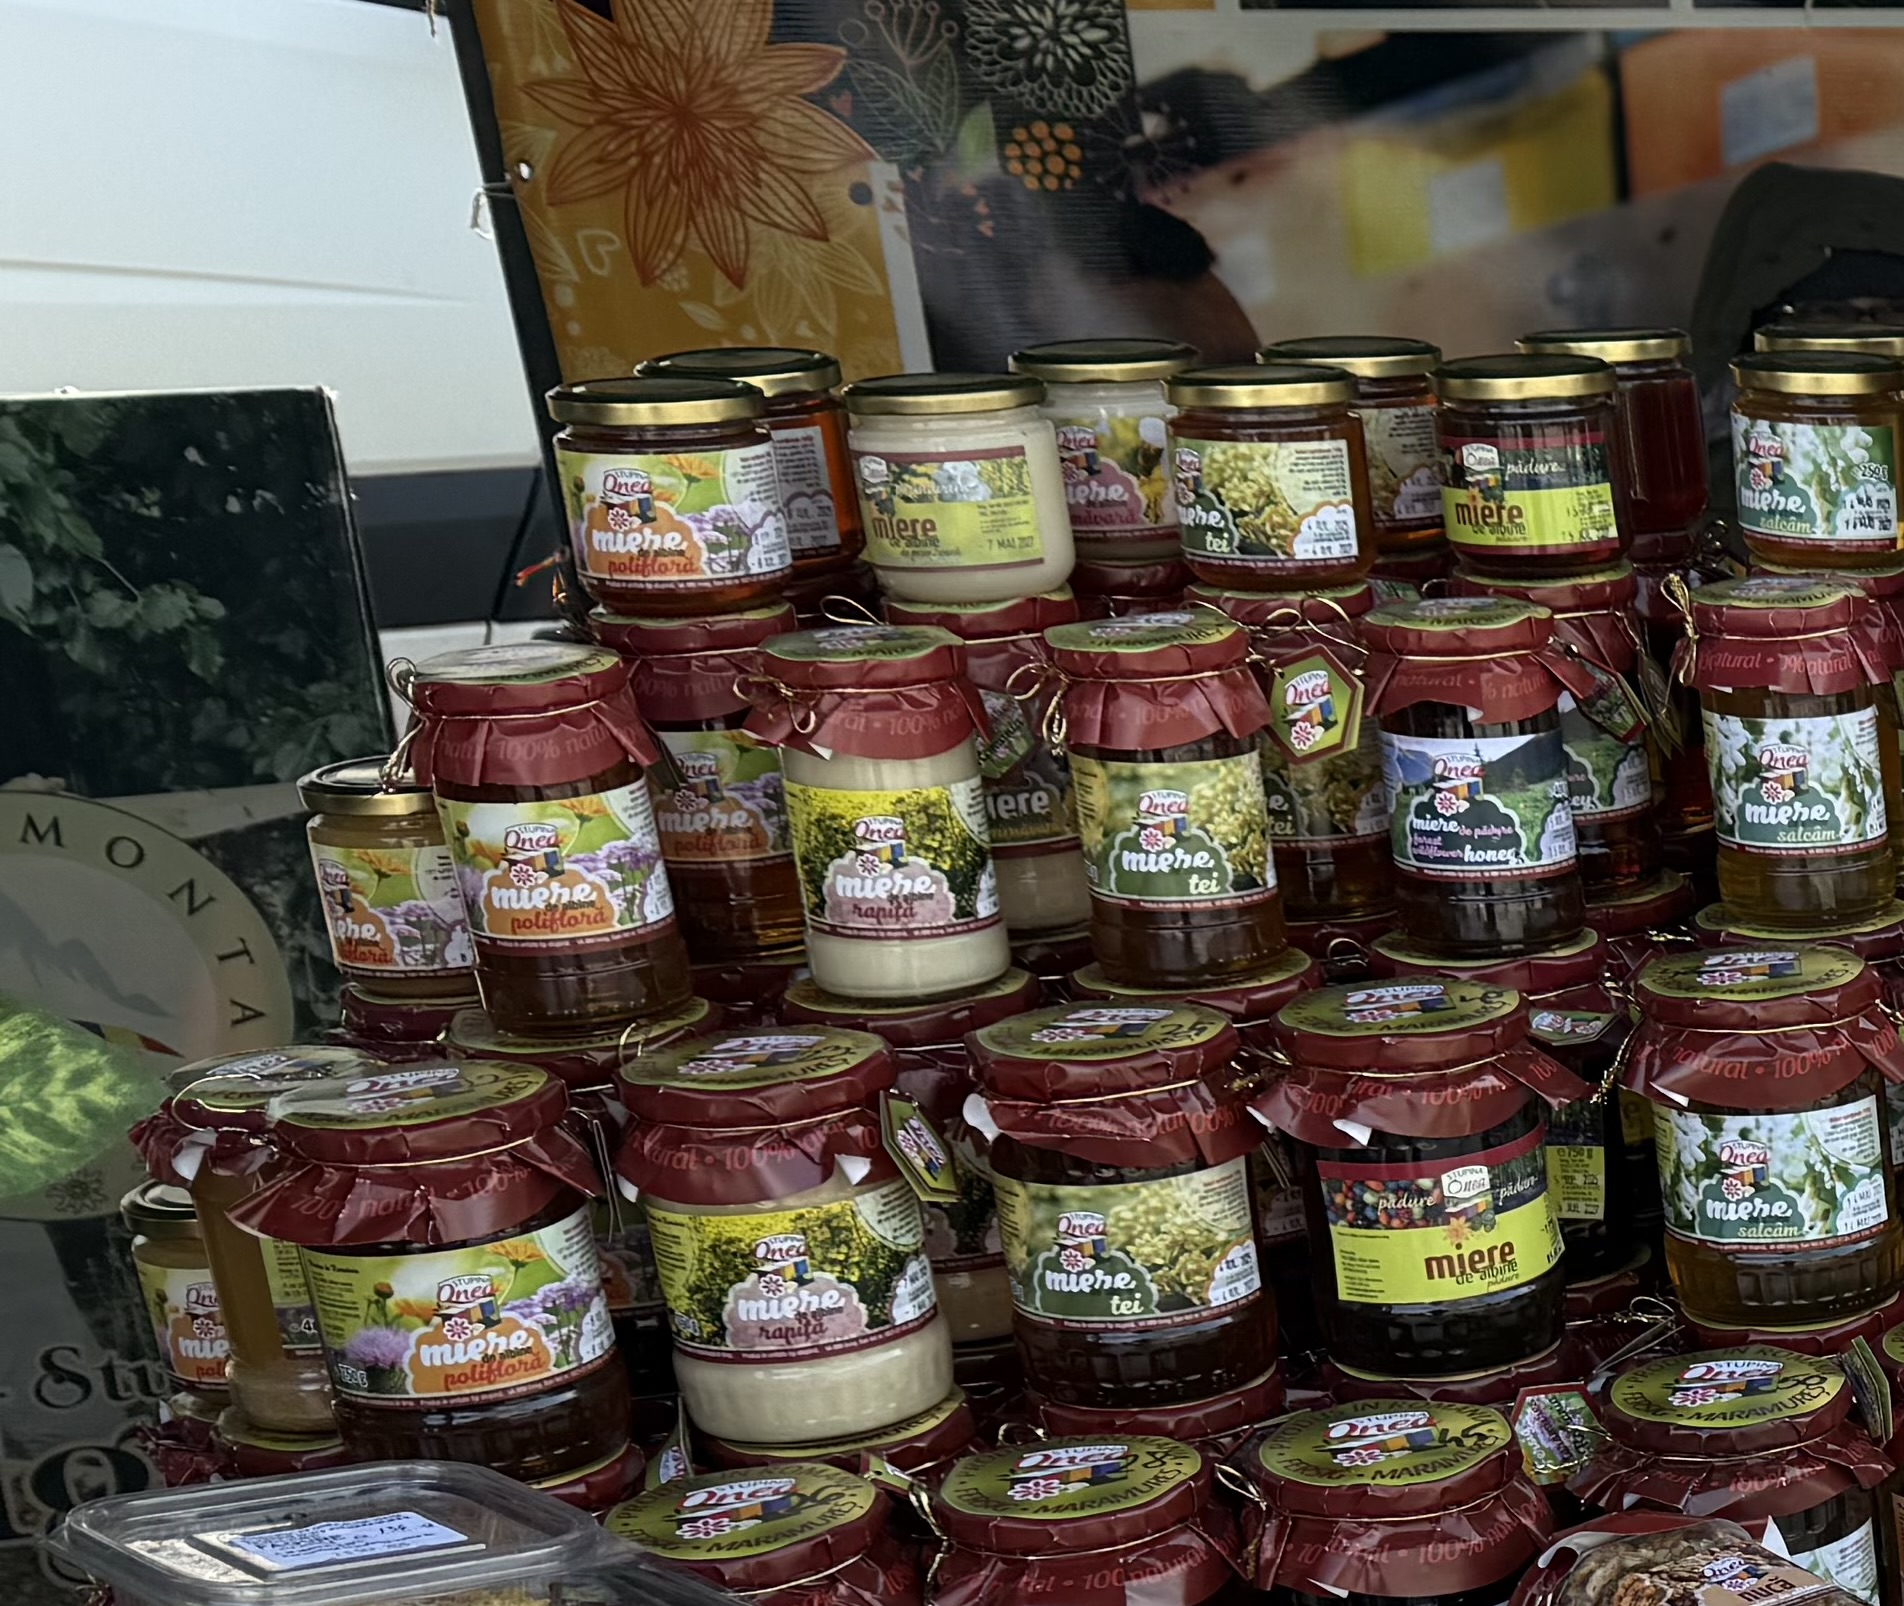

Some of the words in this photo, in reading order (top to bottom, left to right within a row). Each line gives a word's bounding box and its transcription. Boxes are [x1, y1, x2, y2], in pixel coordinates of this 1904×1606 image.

[1456, 500, 1525, 527] miere
[592, 527, 687, 552] miere
[873, 513, 938, 541] miere
[1206, 533, 1231, 553] tei
[658, 809, 754, 833] miere
[1412, 816, 1458, 835] miere
[1745, 801, 1830, 826] miere
[1121, 847, 1215, 874] miere
[1464, 845, 1524, 869] honey
[836, 872, 935, 898] miere
[1188, 871, 1219, 895] tei
[491, 882, 597, 910] miere
[1706, 1199, 1793, 1223] miere
[1738, 1223, 1803, 1242] salcâm
[1424, 1240, 1517, 1283] miere
[1045, 1267, 1136, 1293] miere
[739, 1288, 845, 1321] miere
[1111, 1294, 1142, 1316] tei
[420, 1327, 531, 1367] miere
[444, 1357, 544, 1391] polifloră
